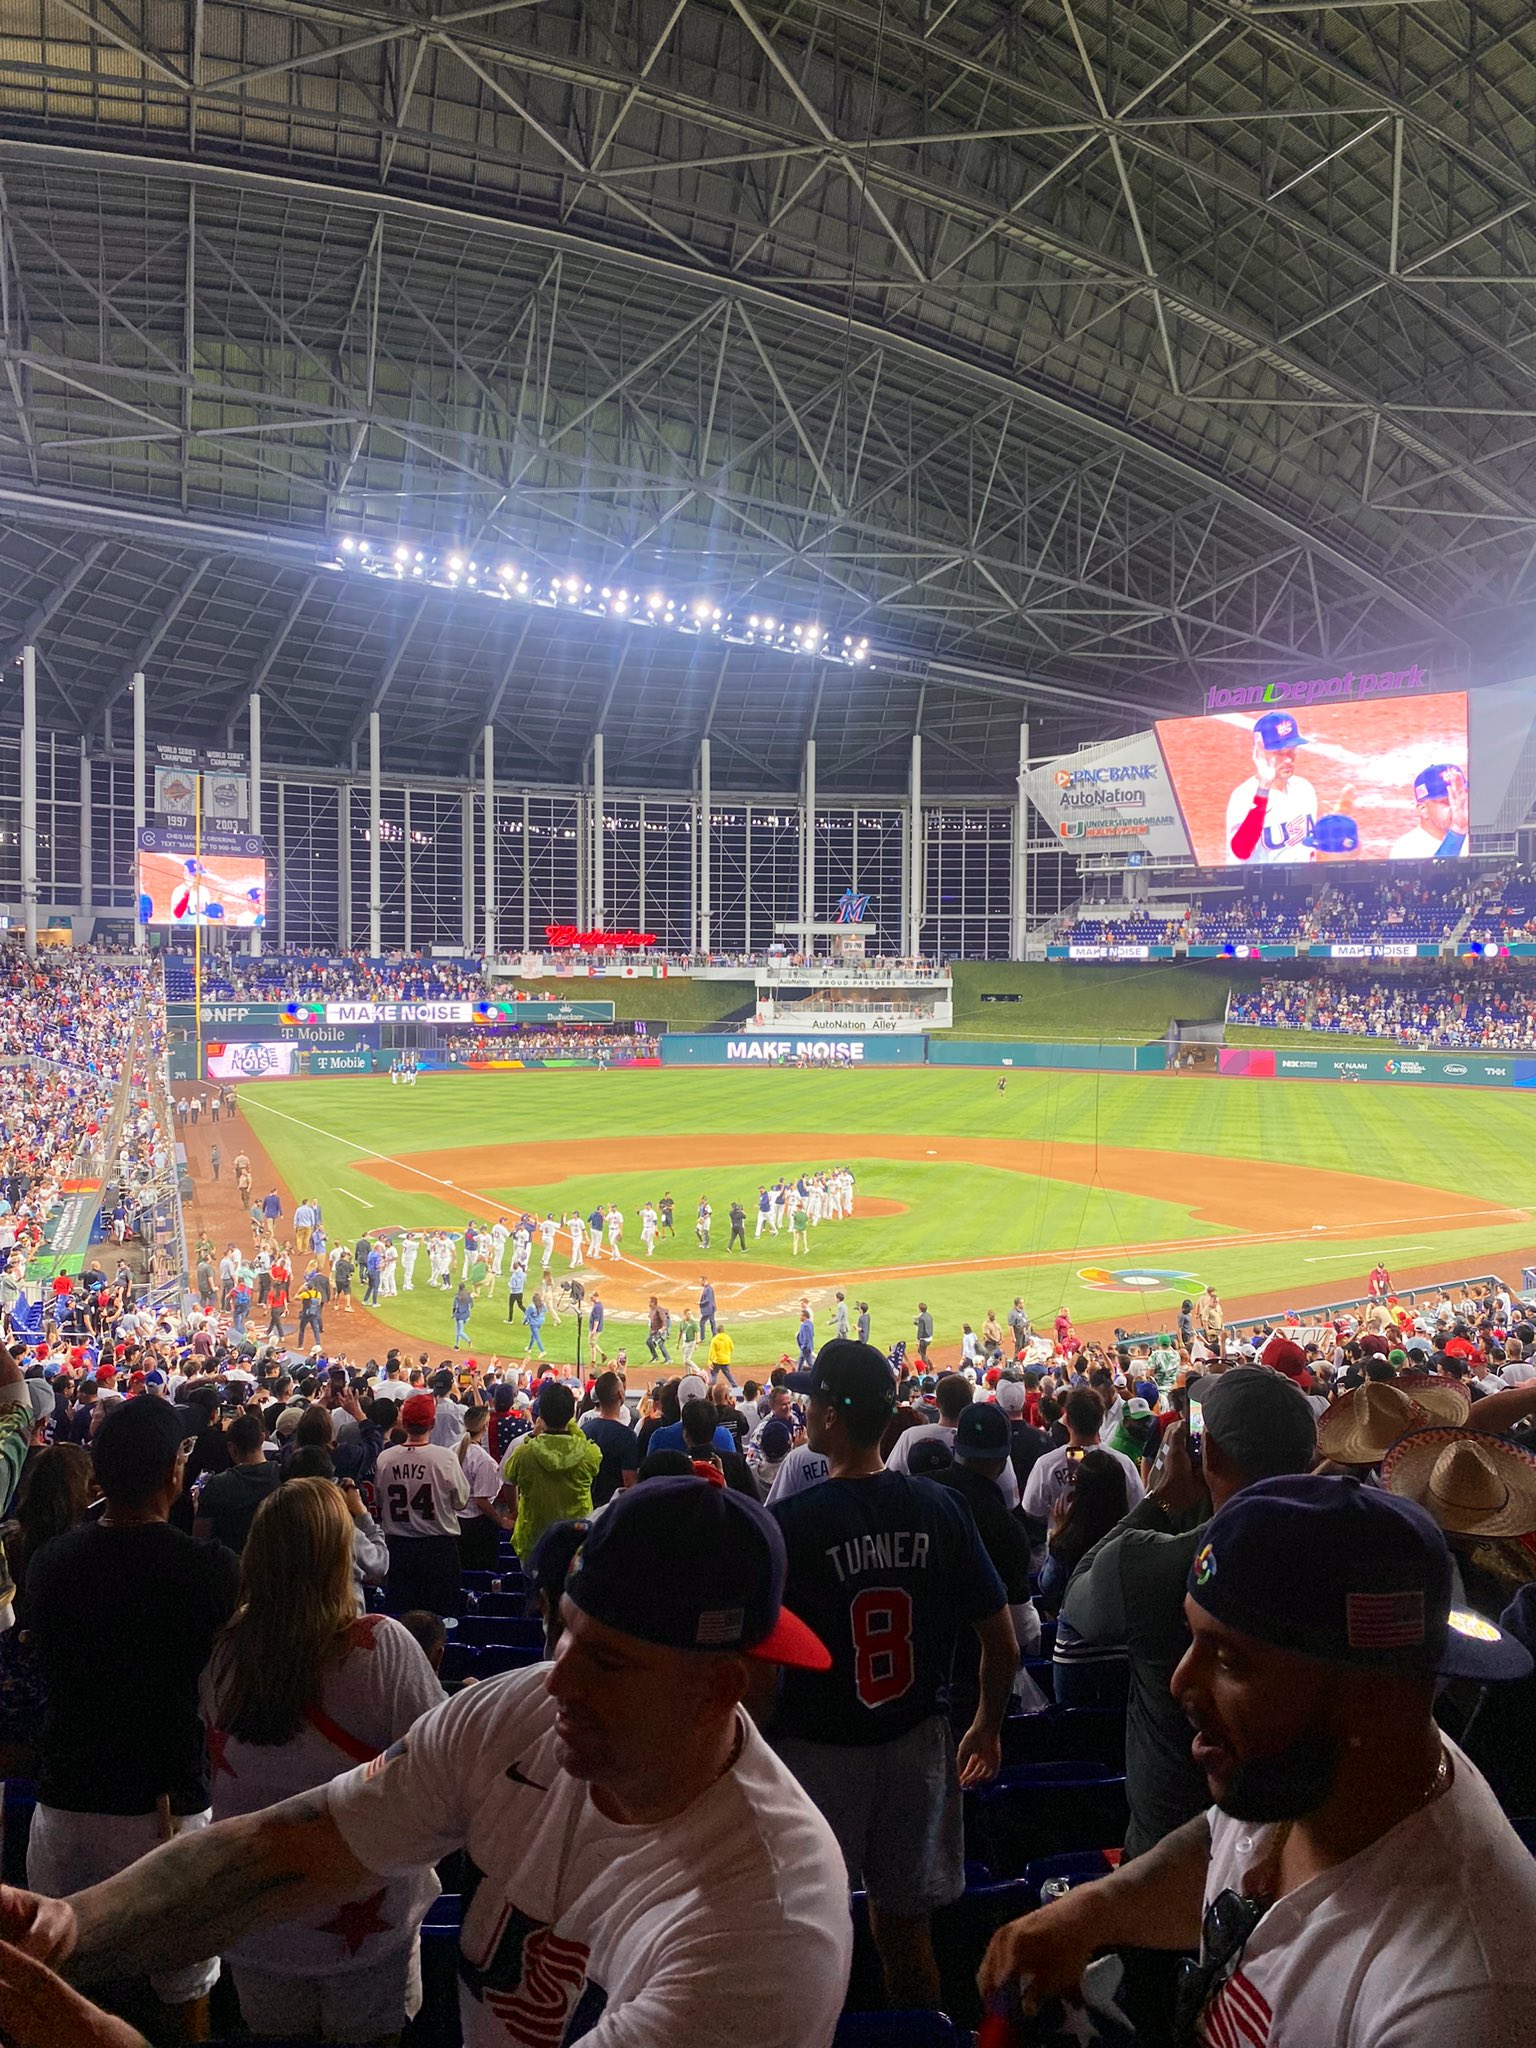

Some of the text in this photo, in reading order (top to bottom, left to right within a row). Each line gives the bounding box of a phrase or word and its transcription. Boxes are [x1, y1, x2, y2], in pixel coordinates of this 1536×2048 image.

[1207, 664, 1425, 708] loanDepot park
[1060, 790, 1143, 807] AutoNation
[167, 816, 187, 827] 1997
[216, 820, 238, 830] 2003
[1129, 855, 1140, 863] 42
[545, 925, 657, 946] Budweiser
[214, 1008, 246, 1022] NFP
[339, 1006, 461, 1020] MAKE NOISE
[812, 1020, 897, 1030] AutoNation Alley
[298, 1028, 345, 1042] Mobile
[234, 1049, 279, 1058] MAKE
[727, 1042, 864, 1060] MAKE NOISE
[232, 1058, 279, 1070] NOISE
[330, 1057, 365, 1068] Mobile
[392, 1464, 426, 1480] MAYS
[387, 1483, 435, 1522] 24
[825, 1532, 930, 1582] TURNER
[850, 1586, 915, 1710] 8
